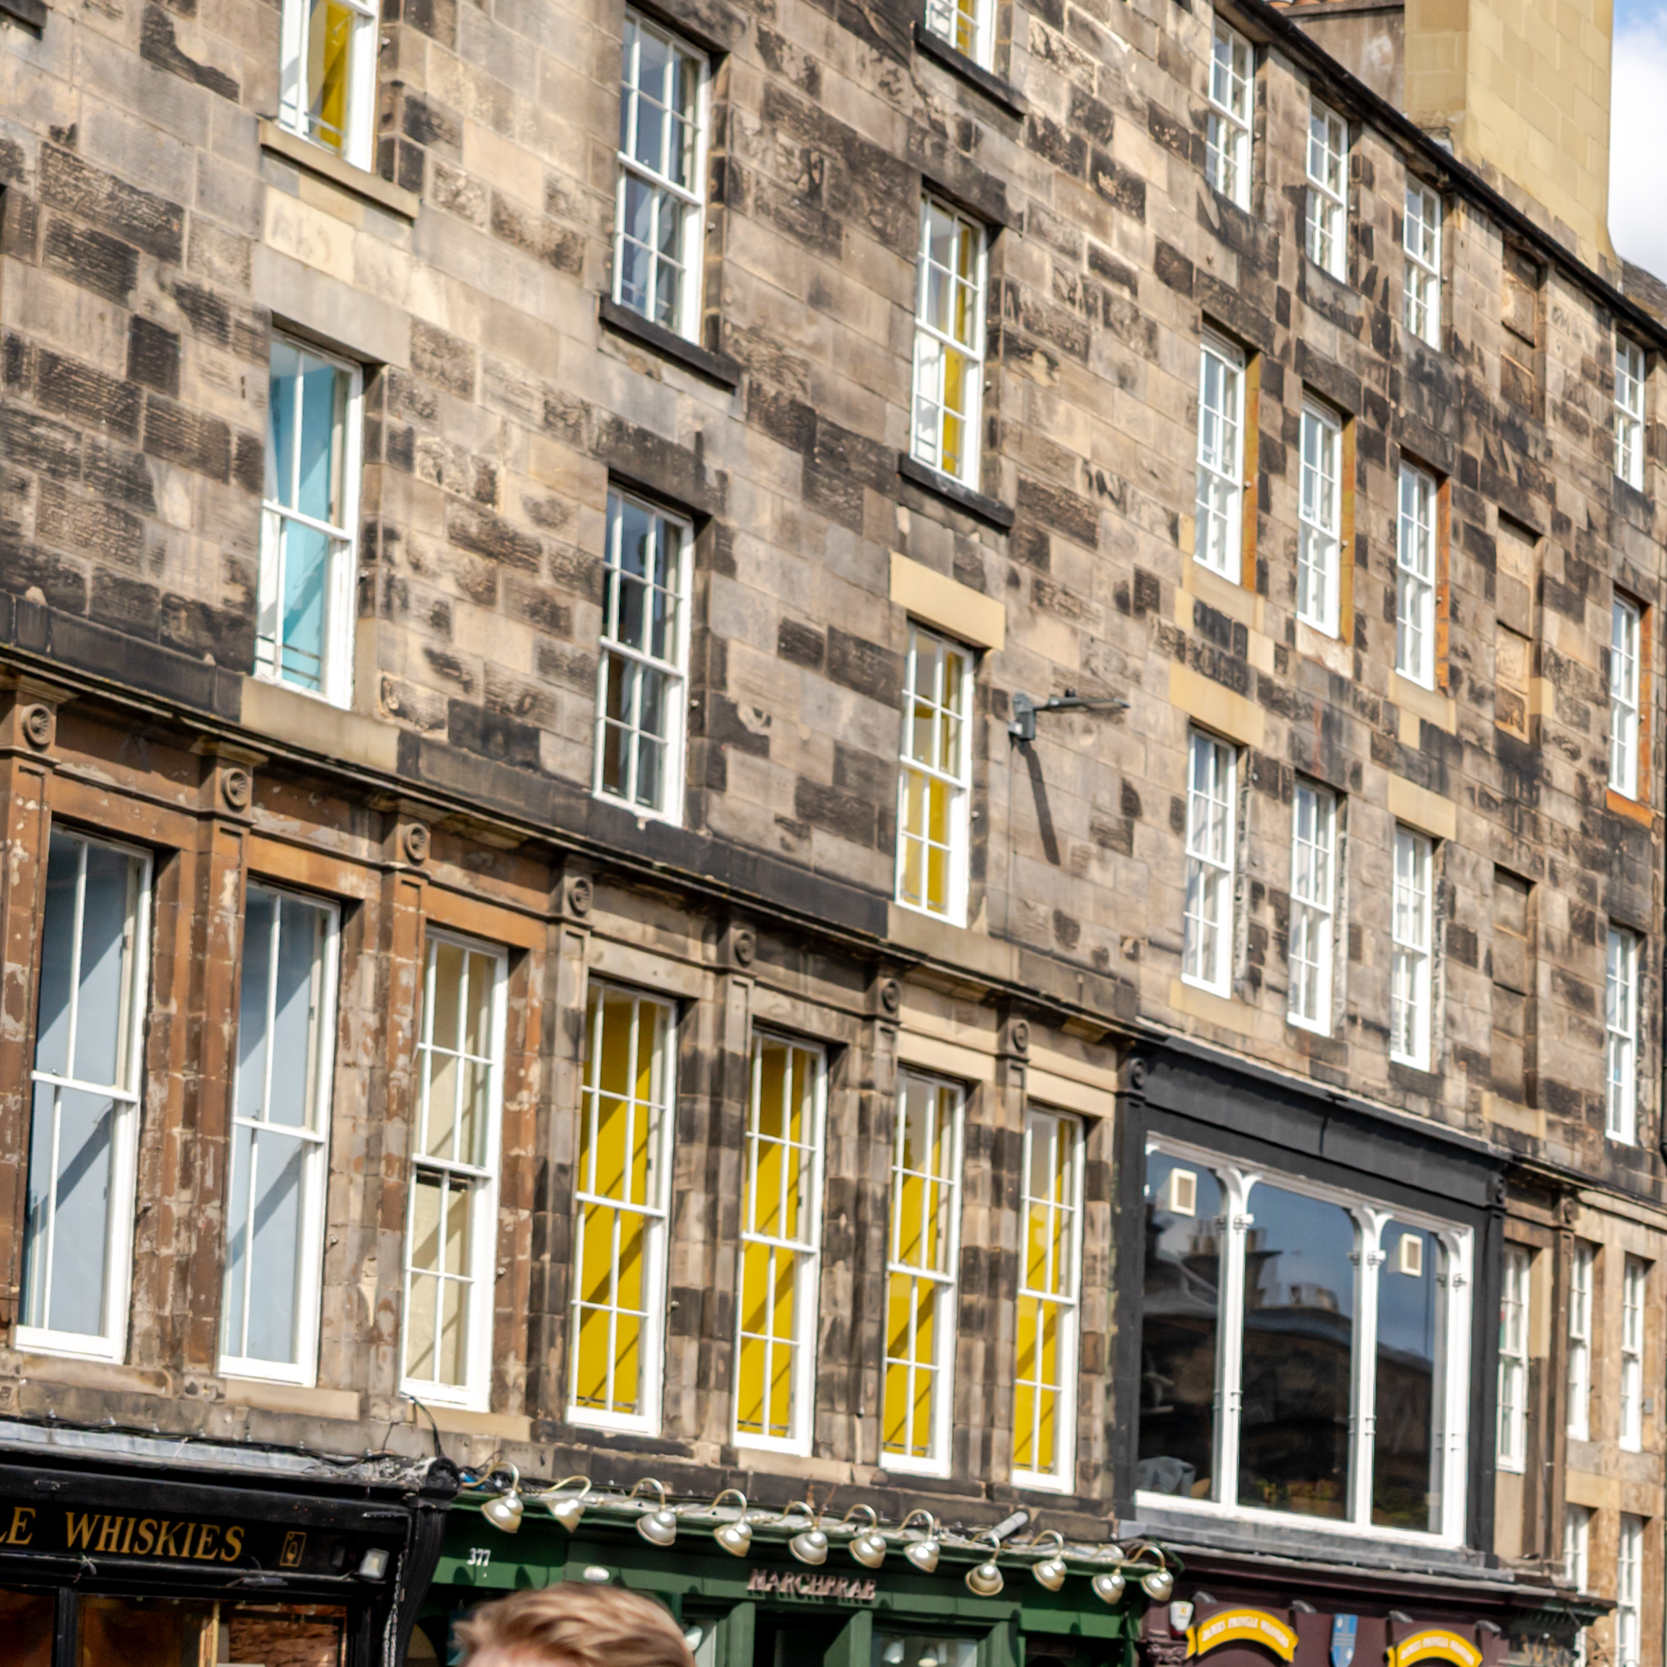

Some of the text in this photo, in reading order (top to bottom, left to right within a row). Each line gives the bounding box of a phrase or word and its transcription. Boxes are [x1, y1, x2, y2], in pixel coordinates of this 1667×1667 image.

[0, 1506, 245, 1562] E WHISKIES
[467, 1547, 491, 1567] 377
